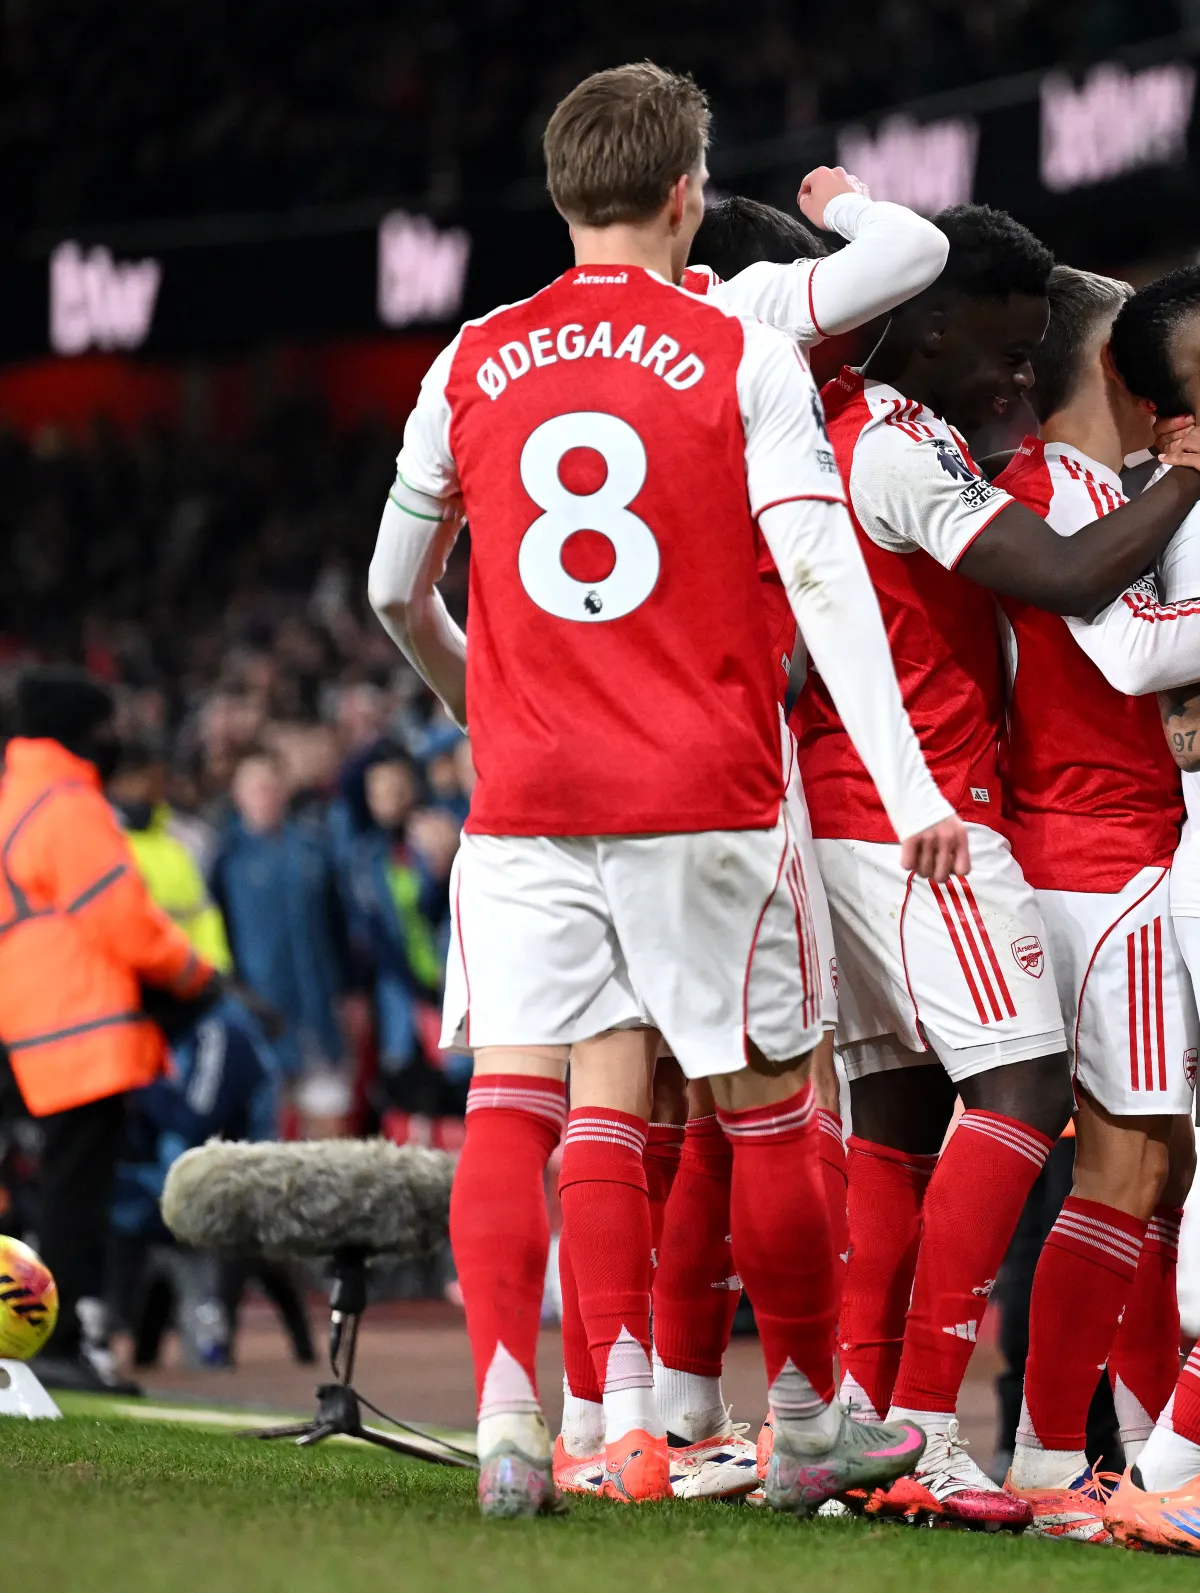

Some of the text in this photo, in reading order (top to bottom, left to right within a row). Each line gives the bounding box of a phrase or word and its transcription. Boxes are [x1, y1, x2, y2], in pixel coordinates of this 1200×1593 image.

[573, 272, 628, 284] Arsenal
[476, 321, 705, 401] ØDEGAARD
[960, 488, 978, 505] No
[518, 411, 661, 623] 8
[1173, 730, 1197, 752] 97
[1017, 942, 1039, 953] Arsenal
